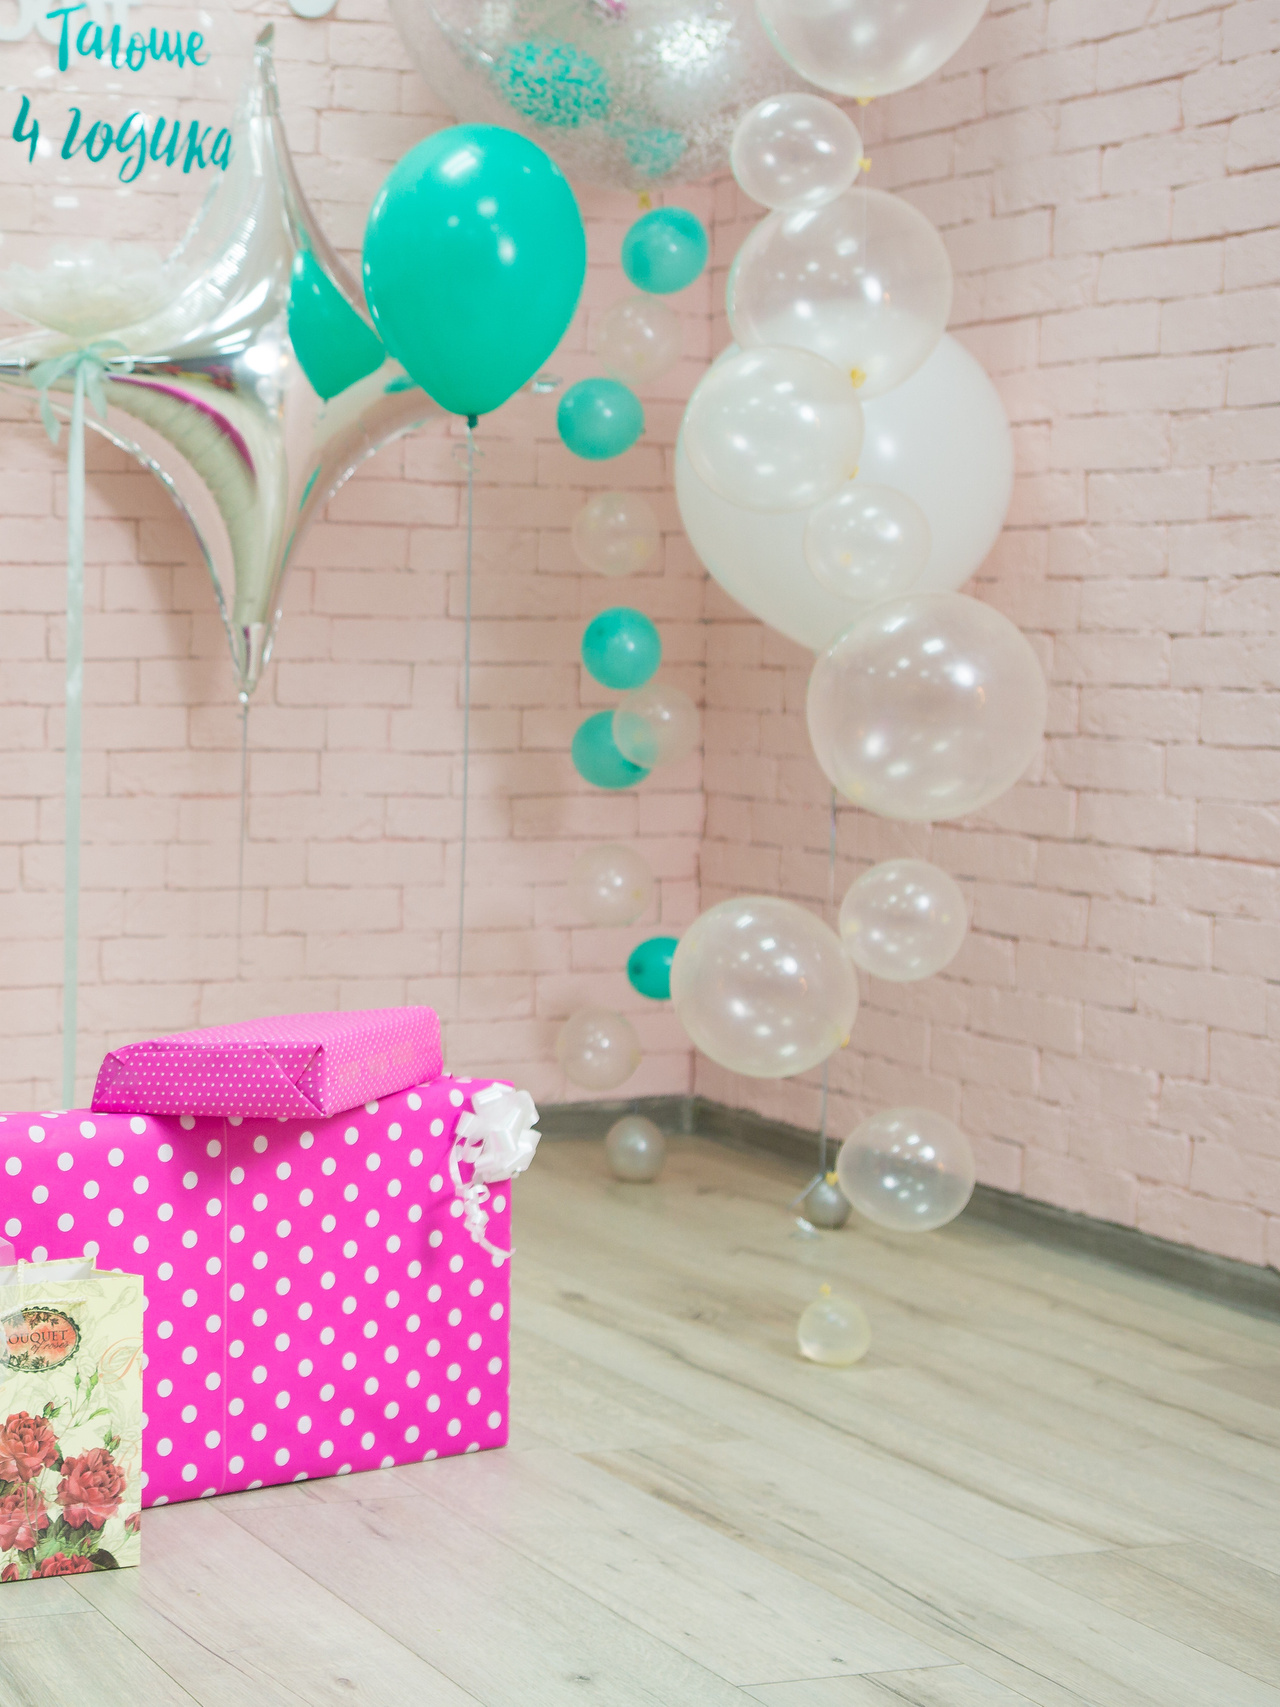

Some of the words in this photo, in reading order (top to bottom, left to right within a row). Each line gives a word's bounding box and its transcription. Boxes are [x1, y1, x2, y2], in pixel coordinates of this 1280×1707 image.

[12, 94, 40, 164] 4
[61, 107, 234, 184] годика
[7, 1329, 69, 1345] OUQUET
